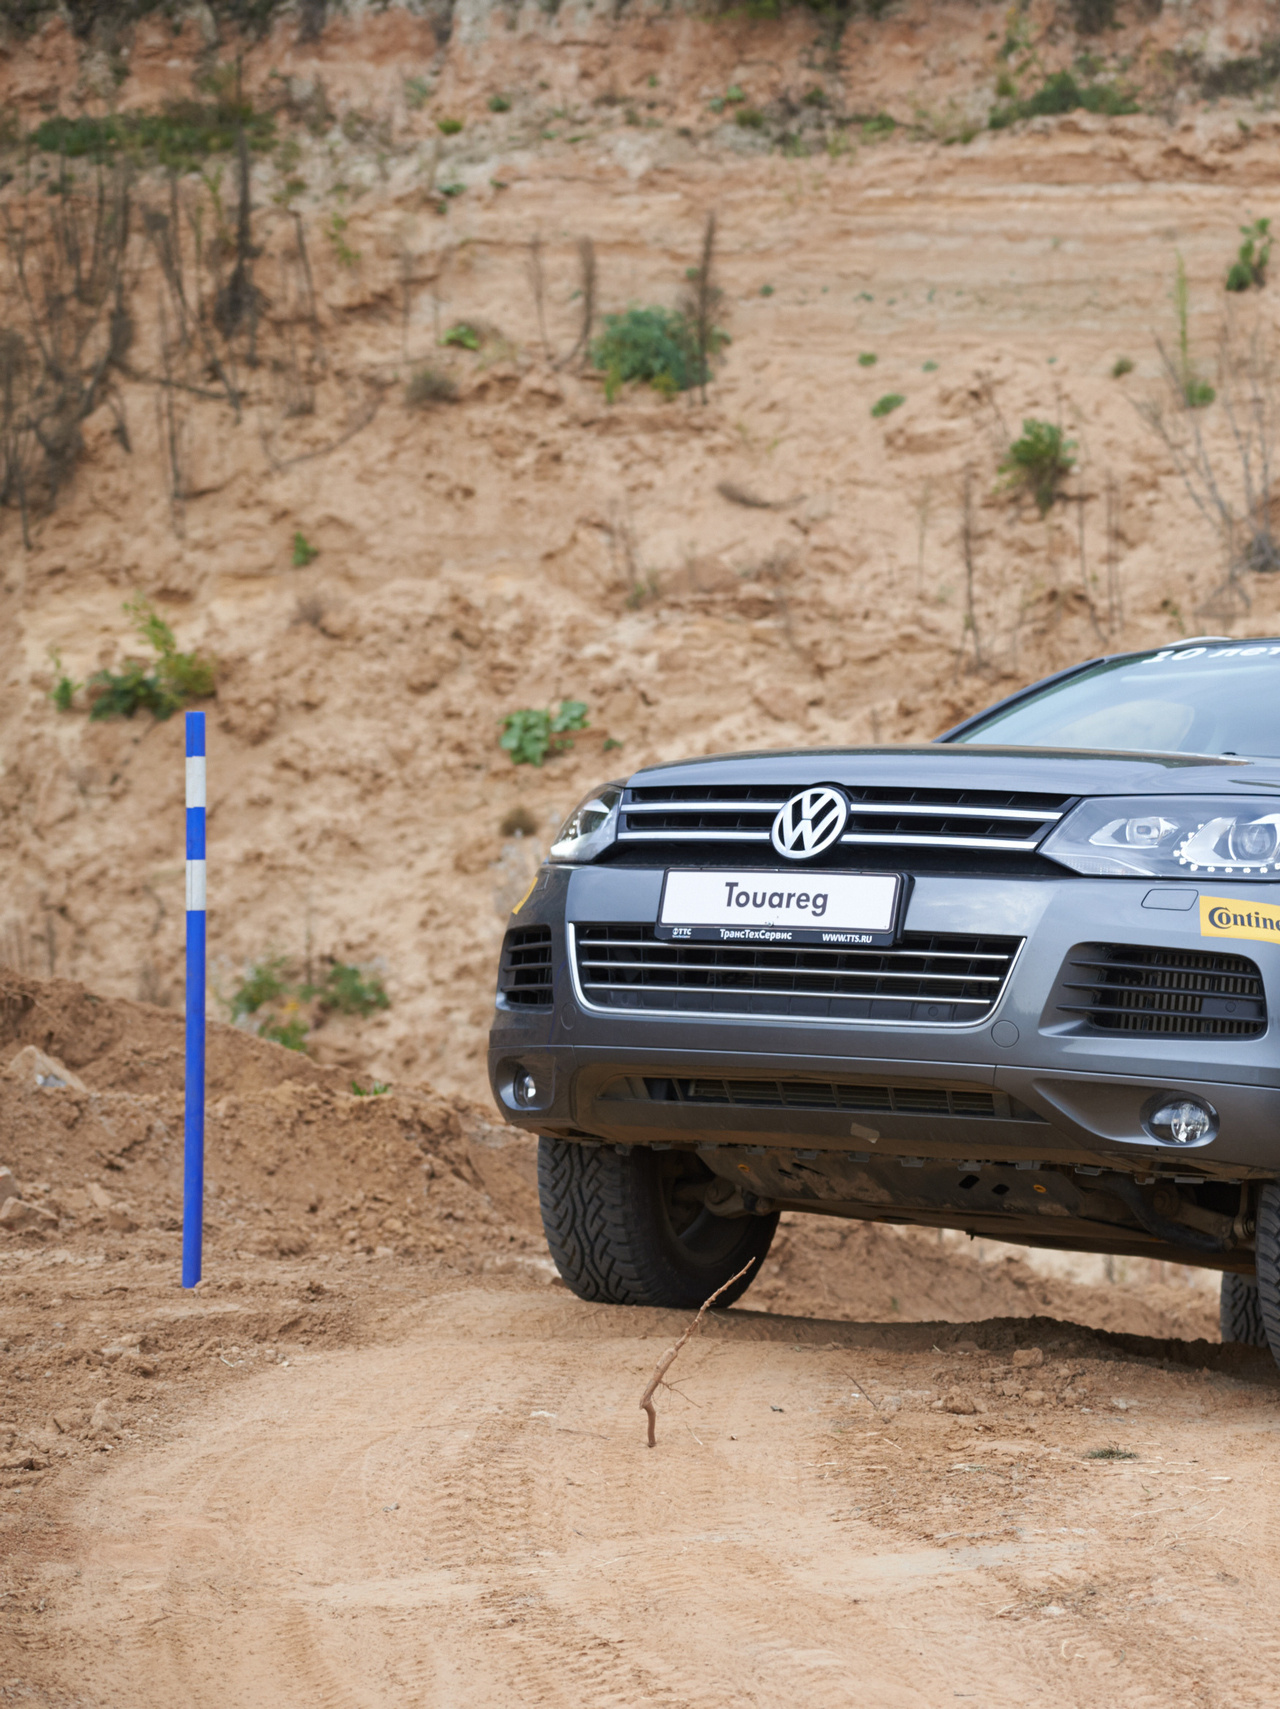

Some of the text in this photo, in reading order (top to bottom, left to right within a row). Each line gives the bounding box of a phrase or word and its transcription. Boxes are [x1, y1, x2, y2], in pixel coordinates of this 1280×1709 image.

[1141, 647, 1207, 664] 10
[724, 882, 829, 917] Touareg
[720, 929, 793, 941] ТрансТехСервис
[822, 933, 873, 944] WWW.TTS.RU
